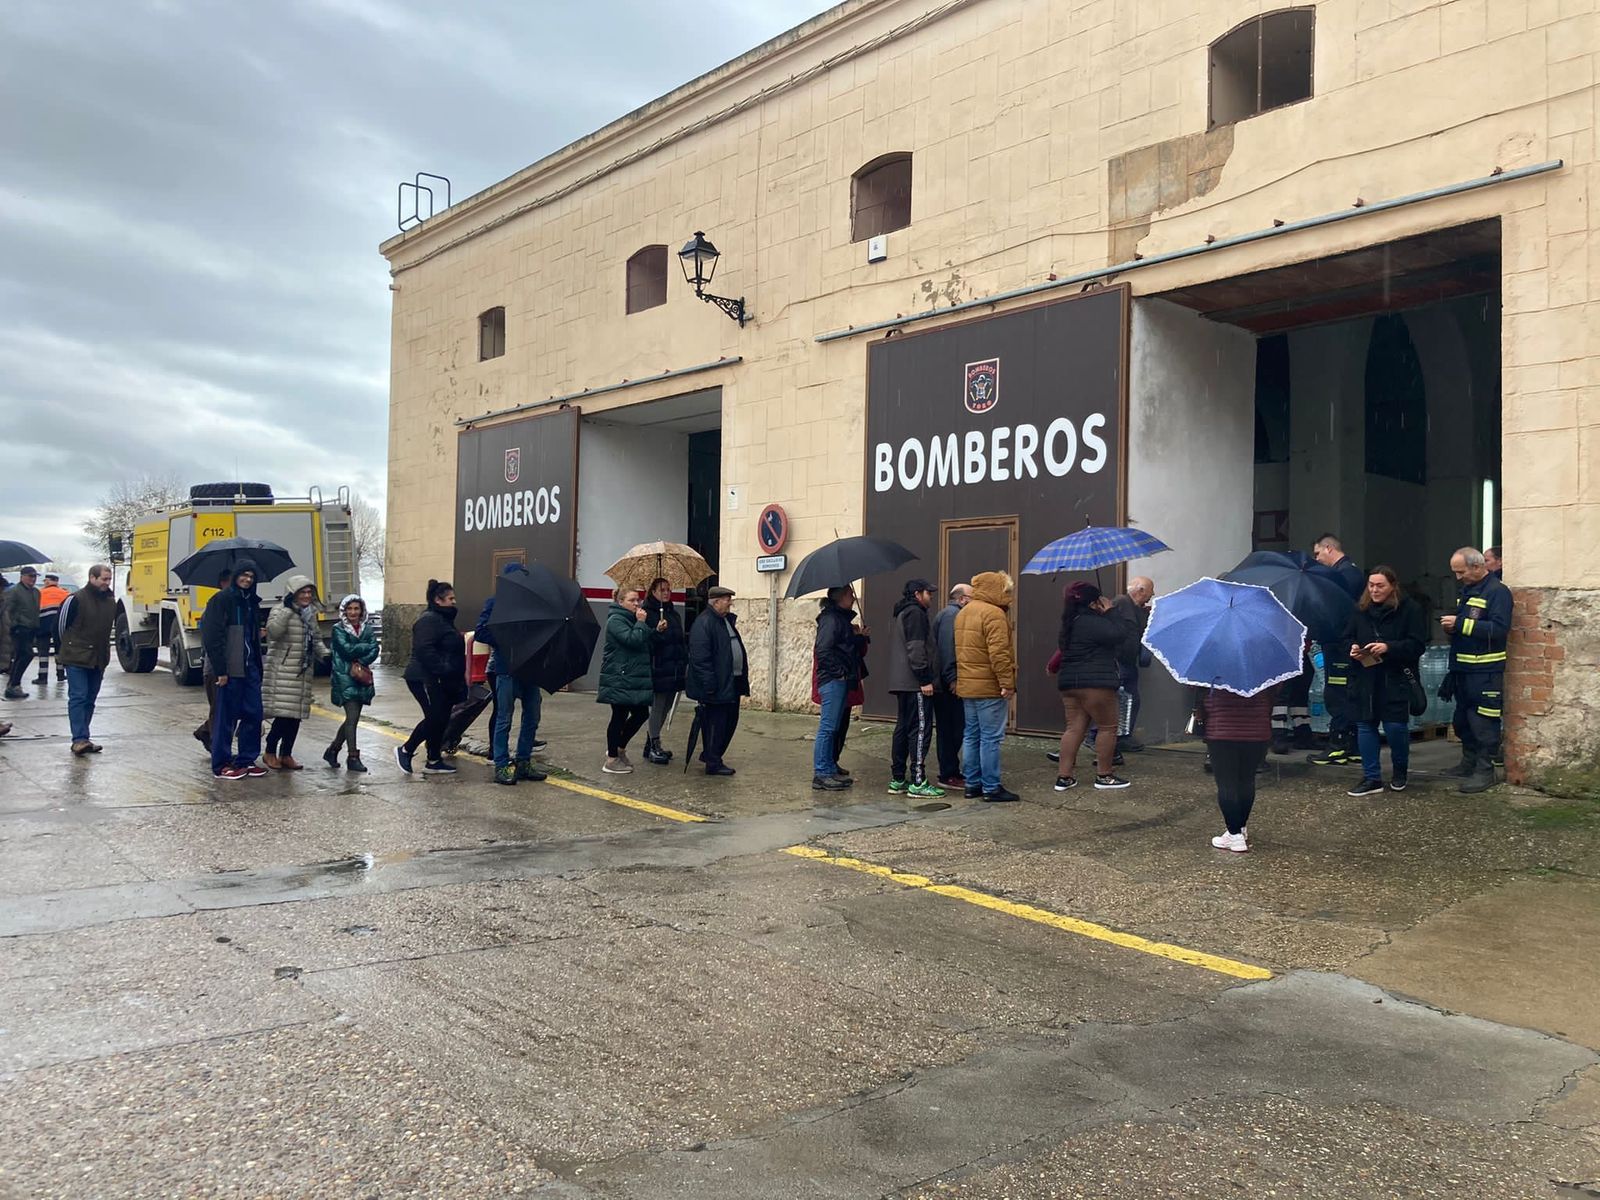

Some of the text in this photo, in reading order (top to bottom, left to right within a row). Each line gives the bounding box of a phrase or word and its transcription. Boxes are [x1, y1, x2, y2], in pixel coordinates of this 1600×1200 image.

[874, 412, 1108, 492] BOMBEROS
[210, 527, 225, 537] 112
[464, 485, 561, 532] BOMBEROS
